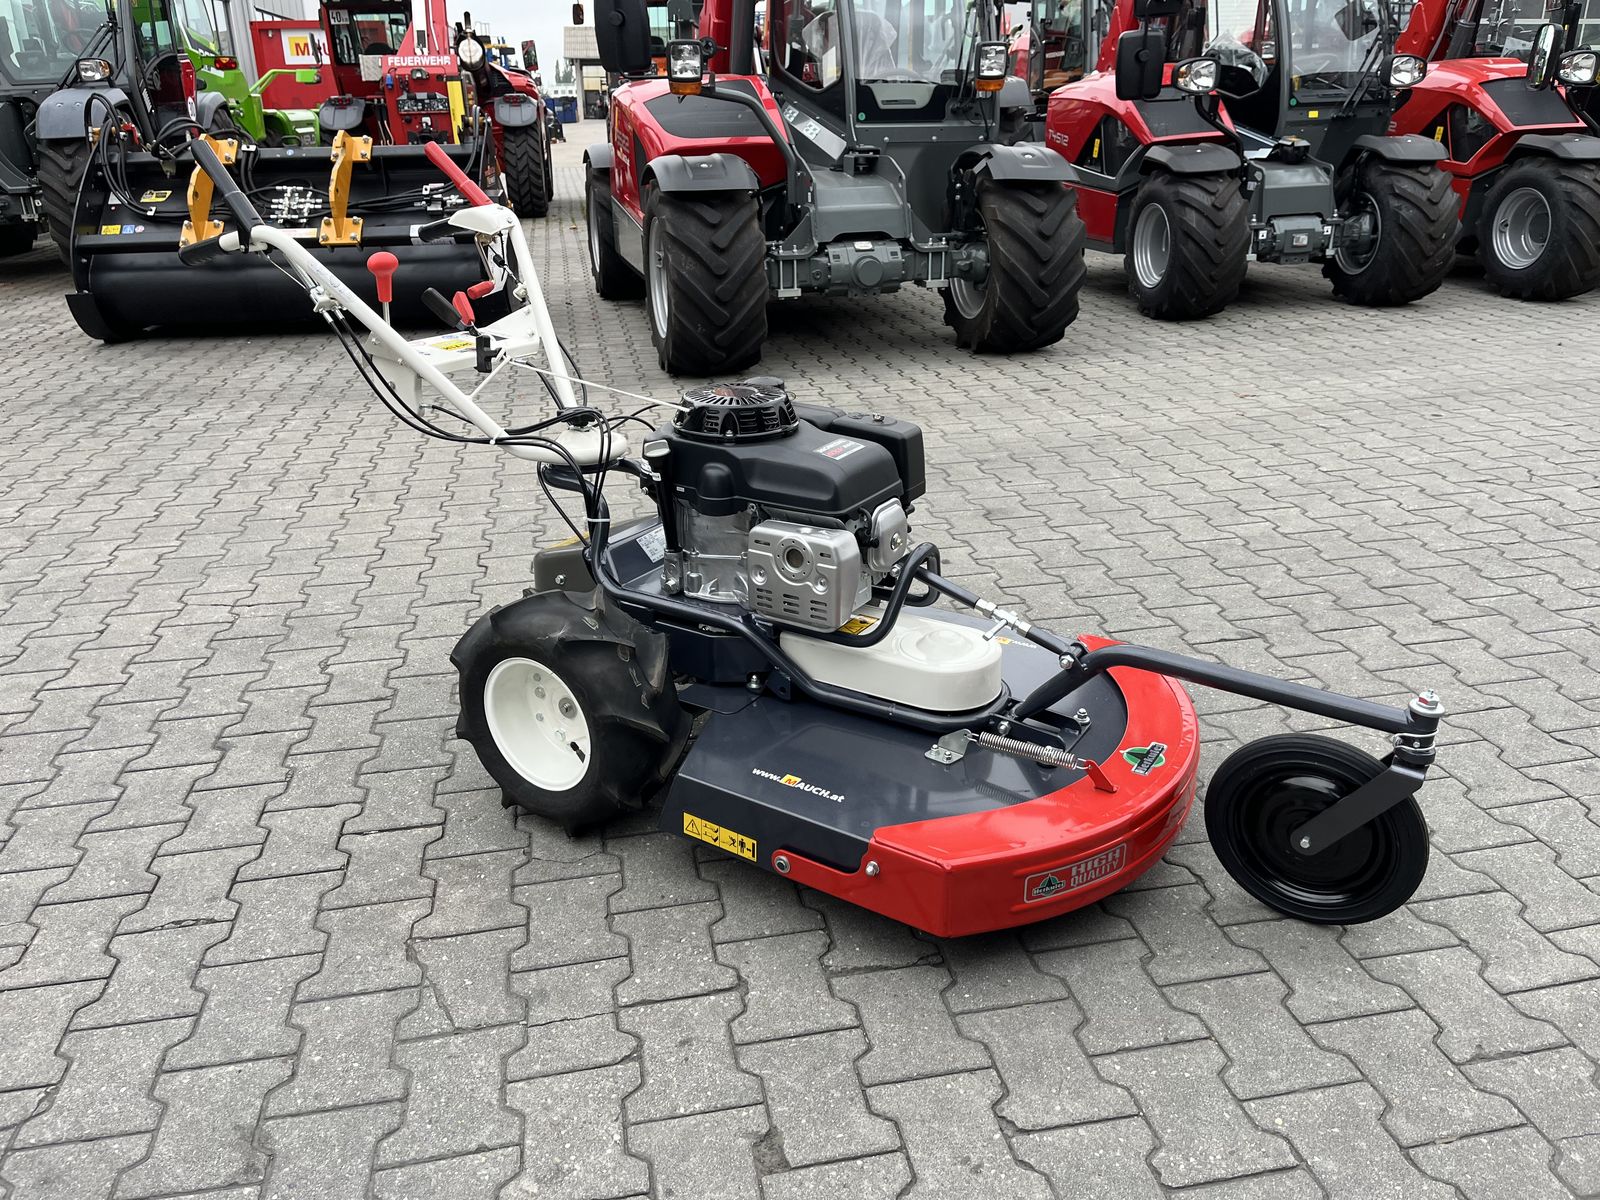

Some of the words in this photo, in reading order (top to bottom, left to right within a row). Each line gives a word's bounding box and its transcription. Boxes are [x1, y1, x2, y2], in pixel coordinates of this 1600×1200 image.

[331, 11, 341, 23] 40
[388, 56, 451, 66] FEUERWEHR
[752, 768, 845, 803] www.MAUCH.at
[1070, 859, 1119, 887] QUALITY
[1072, 848, 1121, 876] HIGH
